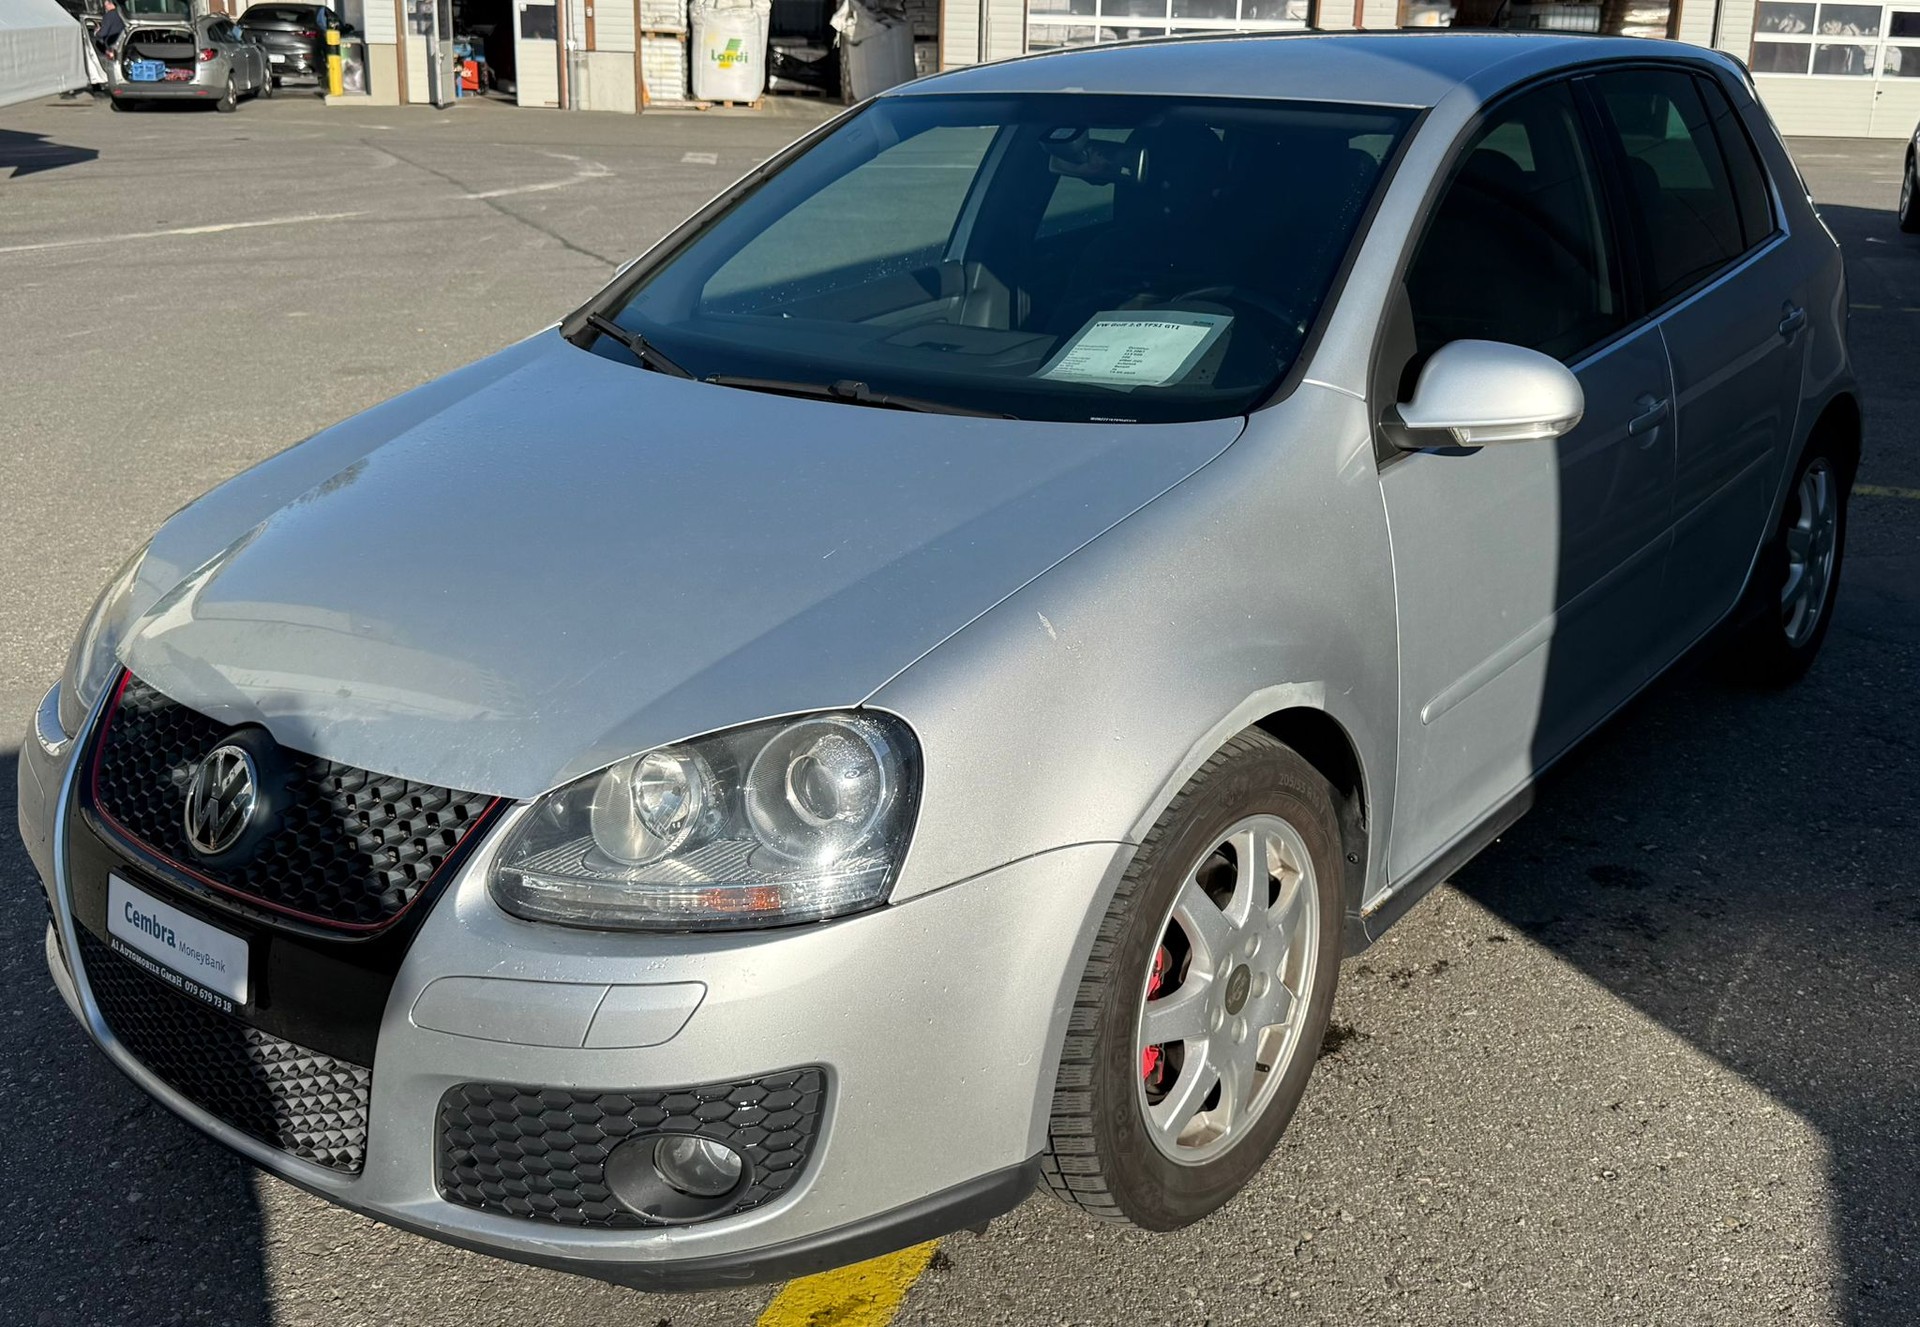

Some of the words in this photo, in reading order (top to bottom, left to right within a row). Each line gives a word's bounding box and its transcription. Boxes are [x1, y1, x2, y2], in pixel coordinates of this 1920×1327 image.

[711, 49, 748, 63] Landi
[1278, 773, 1306, 793] 205/55
[125, 901, 176, 948] Cembra
[179, 941, 226, 973] MoneyBank
[111, 939, 119, 951] A1
[185, 981, 198, 995] 079
[199, 988, 213, 1002] 679
[214, 995, 222, 1007] 73
[223, 1000, 232, 1012] 18
